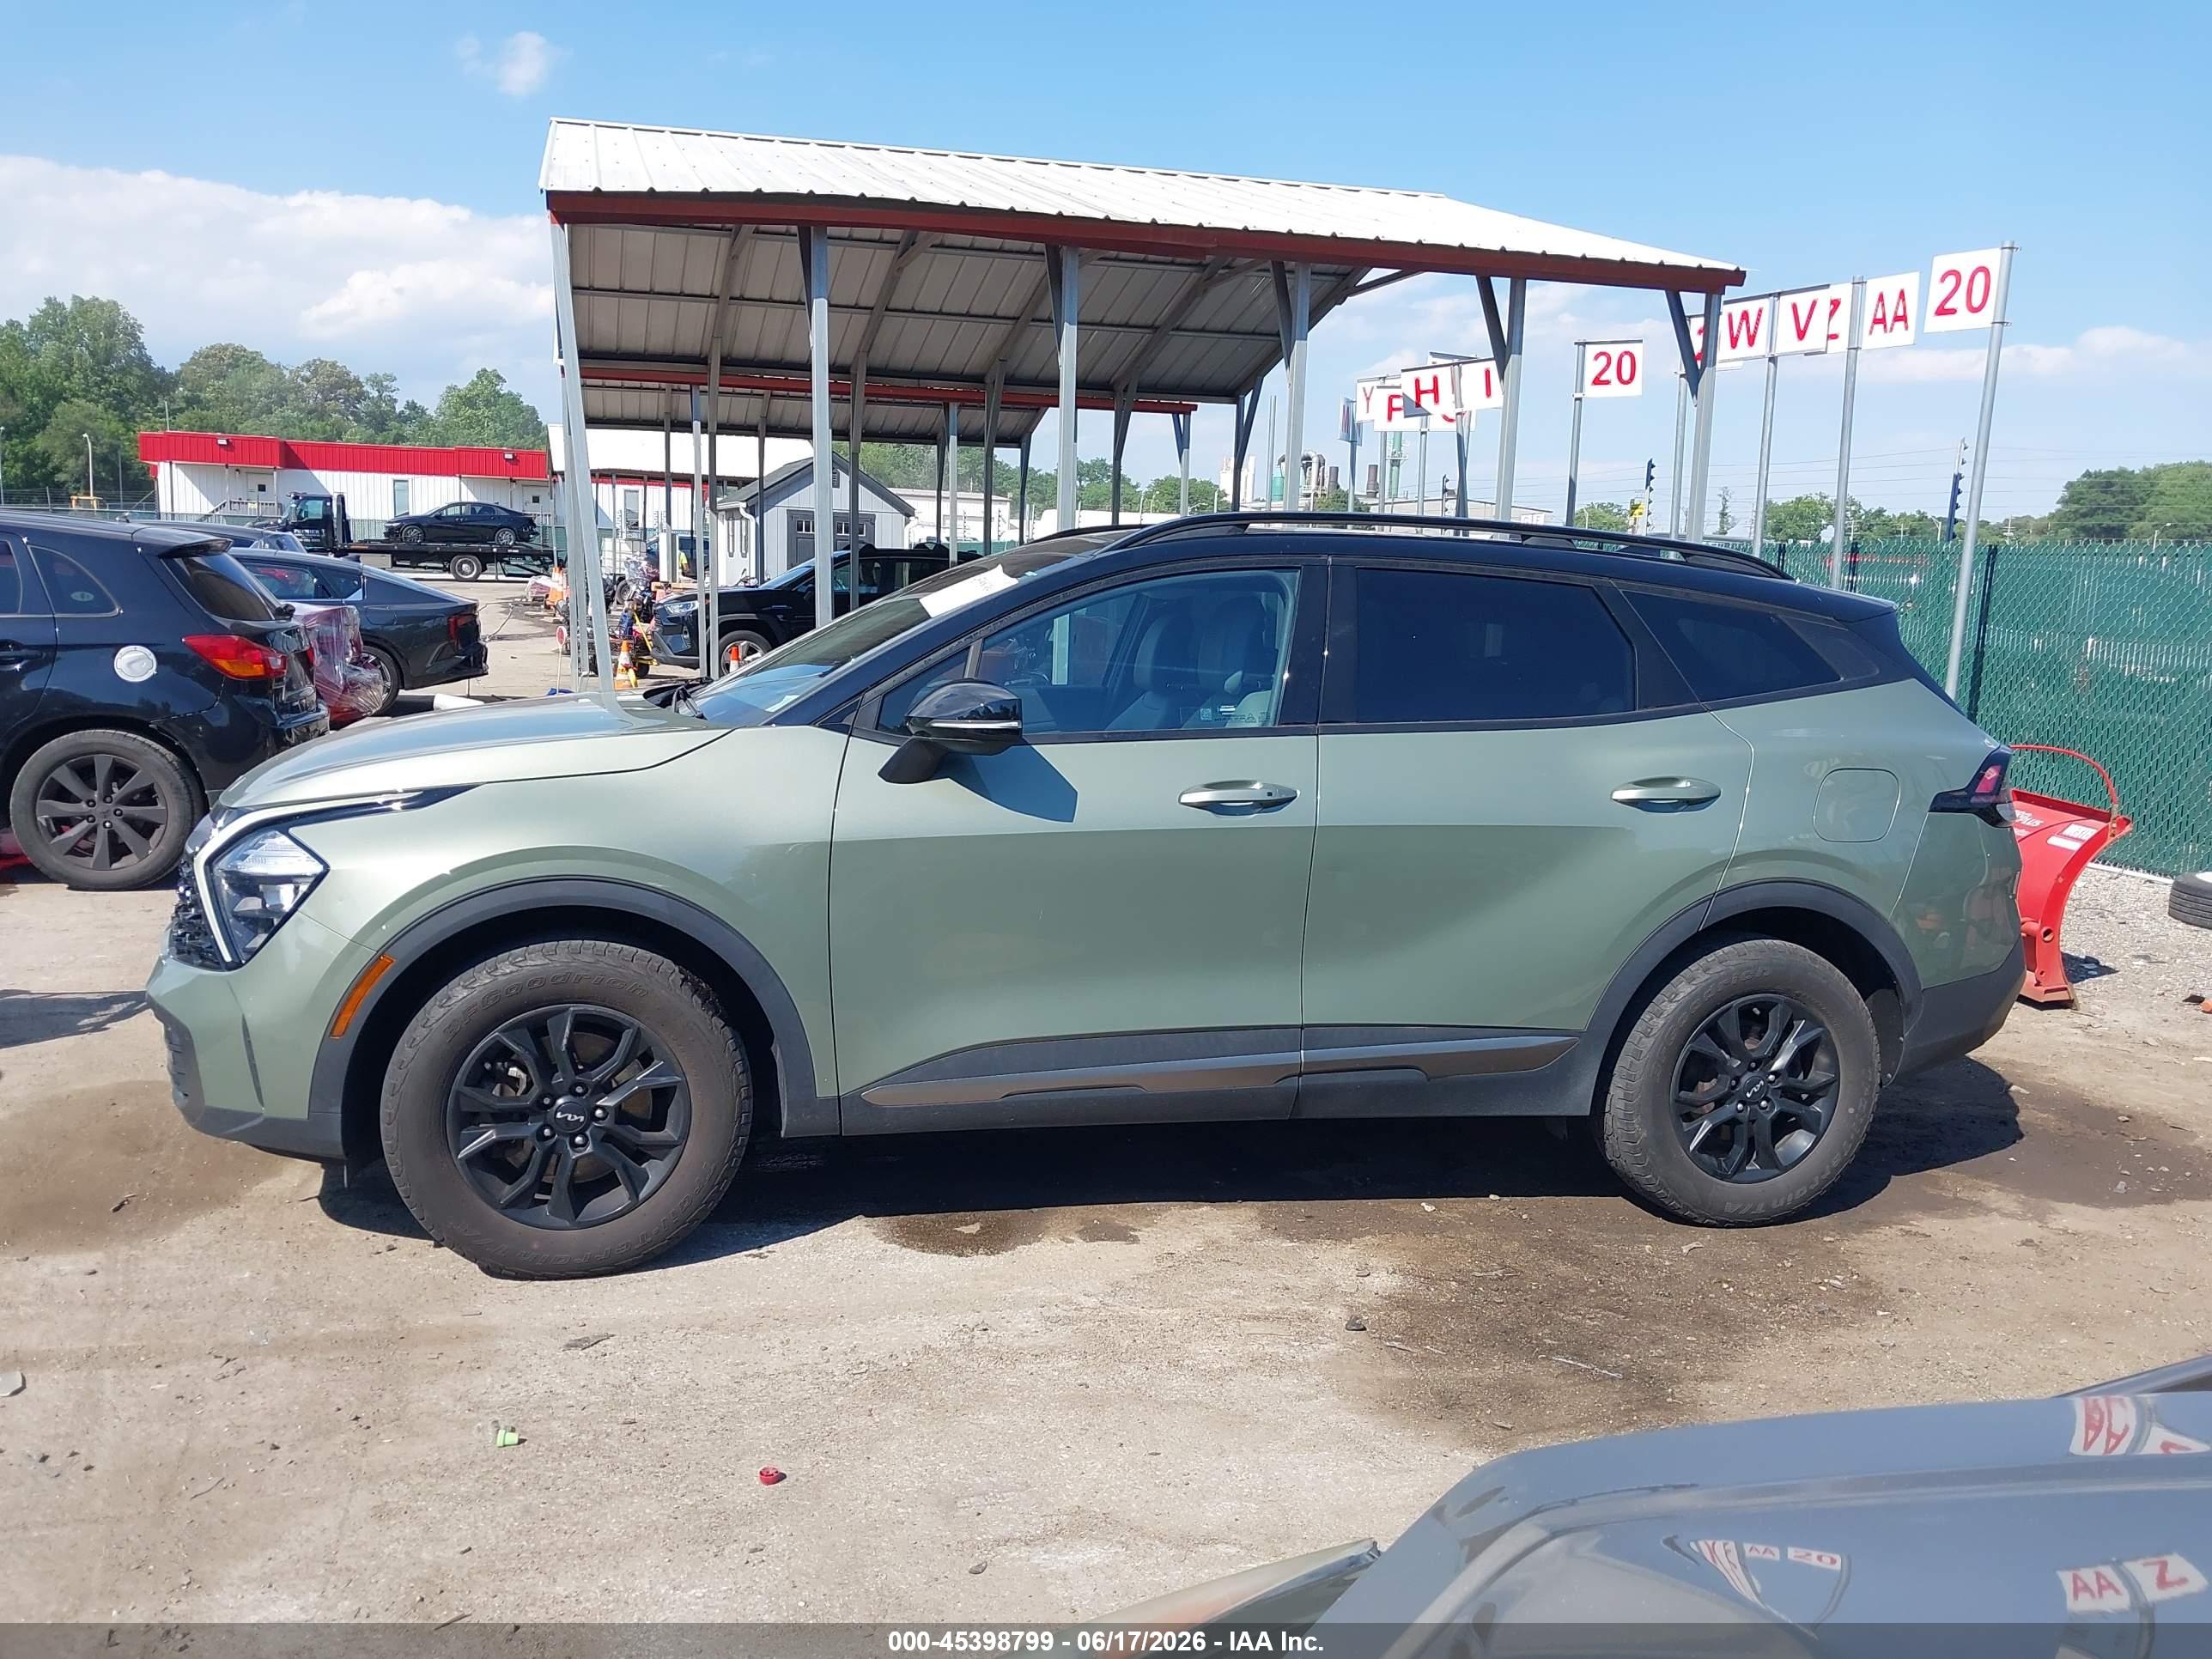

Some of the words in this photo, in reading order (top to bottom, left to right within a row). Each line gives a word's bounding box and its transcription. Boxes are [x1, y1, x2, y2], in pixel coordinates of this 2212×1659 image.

[1869, 289, 1909, 336] AA
[1934, 265, 1991, 317] 20
[1727, 307, 1764, 350] W
[1790, 299, 1819, 342] V
[1590, 350, 1637, 386] 20
[1362, 386, 1375, 414] Y
[1414, 374, 1440, 409] H
